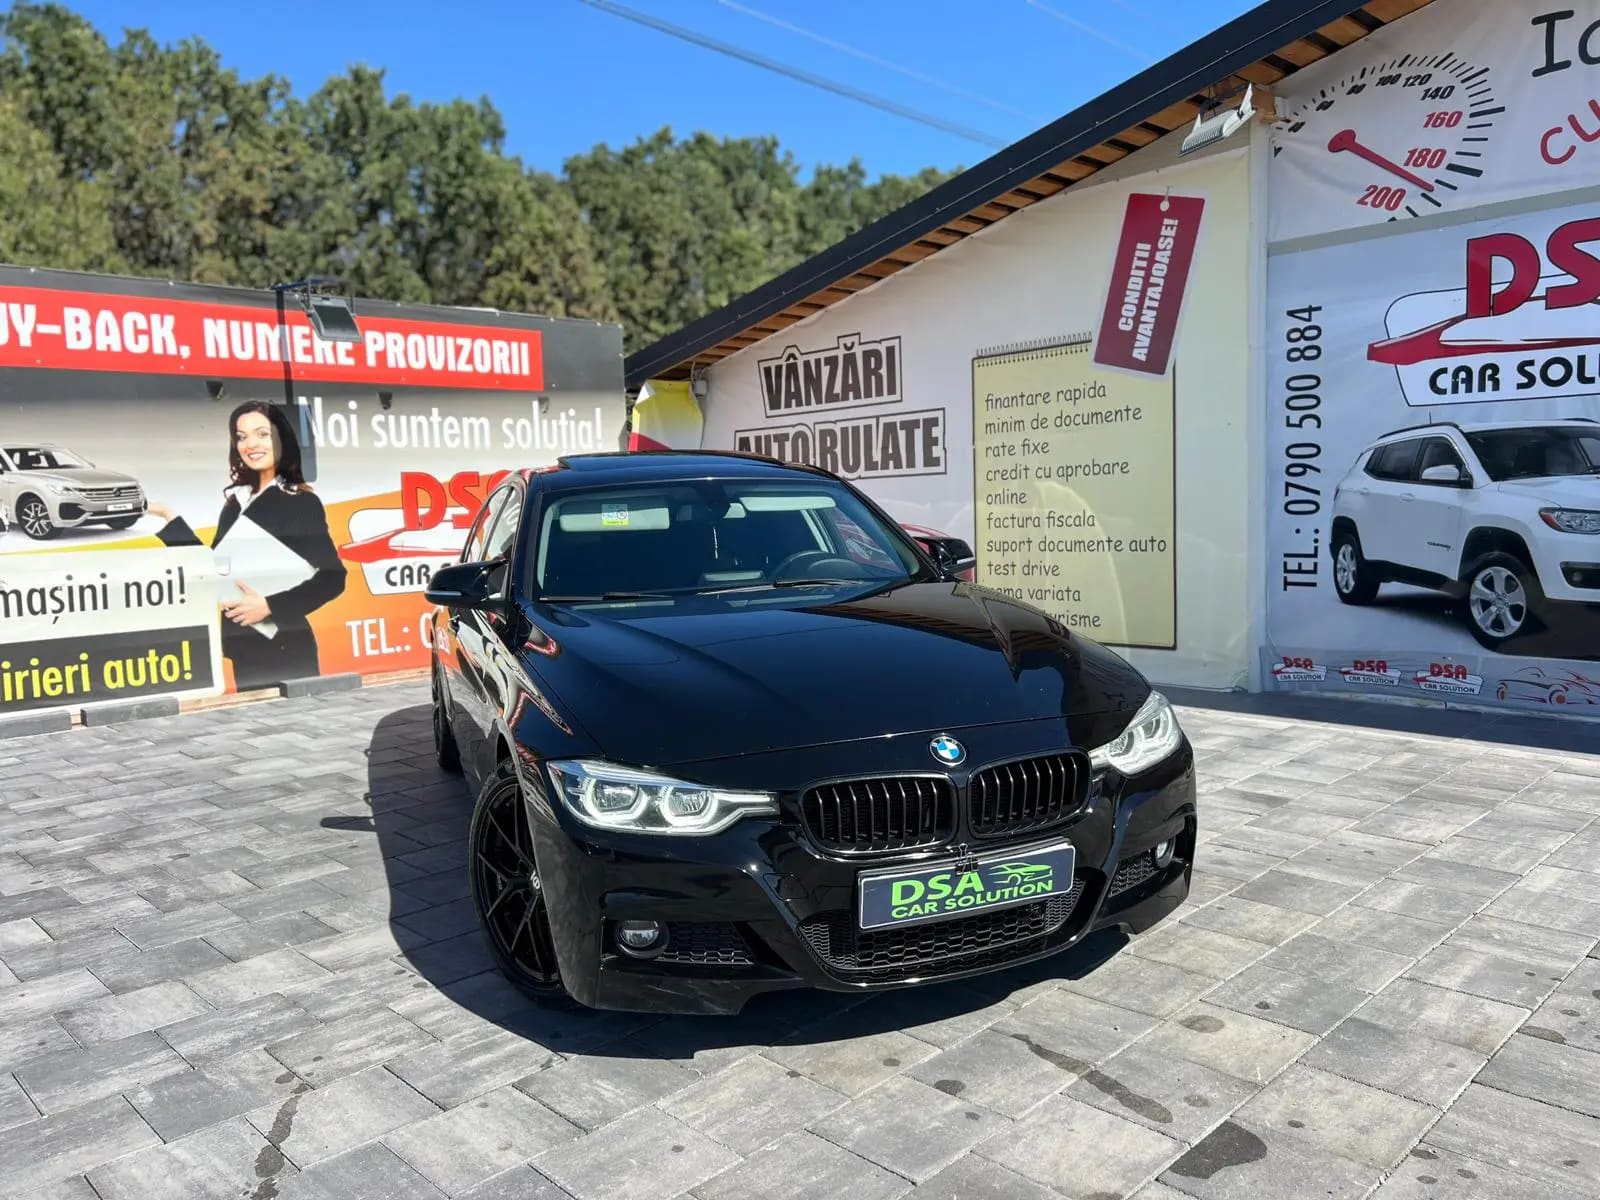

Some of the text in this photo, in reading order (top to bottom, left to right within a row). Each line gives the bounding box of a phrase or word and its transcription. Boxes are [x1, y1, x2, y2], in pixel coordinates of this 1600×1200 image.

[1531, 9, 1600, 77] I
[1376, 73, 1402, 87] 100
[1402, 73, 1432, 87] 120
[1420, 85, 1455, 101] 140
[1422, 110, 1464, 129] 160
[1403, 147, 1447, 169] 180
[1356, 184, 1407, 211] 200
[1118, 242, 1151, 331] CONDITII
[1132, 218, 1179, 362] AVANTAJOASE!
[203, 317, 356, 367] NUMERE
[365, 330, 531, 376] PROVIZORII
[763, 341, 898, 411] VÂNZĂRI
[1428, 353, 1600, 395] CAR SOL
[985, 381, 1106, 412] finantare rapida
[298, 396, 360, 448] Noi
[371, 407, 491, 450] suntem
[985, 405, 1142, 435] minim de documente
[985, 438, 1050, 458] rate fixe
[1283, 304, 1323, 592] TEL.: 0790 500 884
[985, 458, 1130, 482] credit cu aprobare
[400, 469, 515, 532] DS
[986, 488, 1027, 505] online
[986, 509, 1096, 528] factura fiscala
[986, 536, 1168, 557] suport documente auto
[385, 563, 431, 587] CAR
[987, 560, 1061, 577] test drive
[124, 566, 186, 608] noi!
[1028, 585, 1081, 602] variata
[345, 617, 412, 658] TEL.:
[103, 640, 193, 690] auto!
[1282, 656, 1313, 670] DSA
[1353, 659, 1387, 673] DSA
[1429, 662, 1467, 680] DSA
[1362, 675, 1394, 685] SOLUTION
[1438, 684, 1475, 693] SOLUTION
[891, 870, 984, 907] DSA
[891, 879, 1053, 919] CAR SOLUTION
